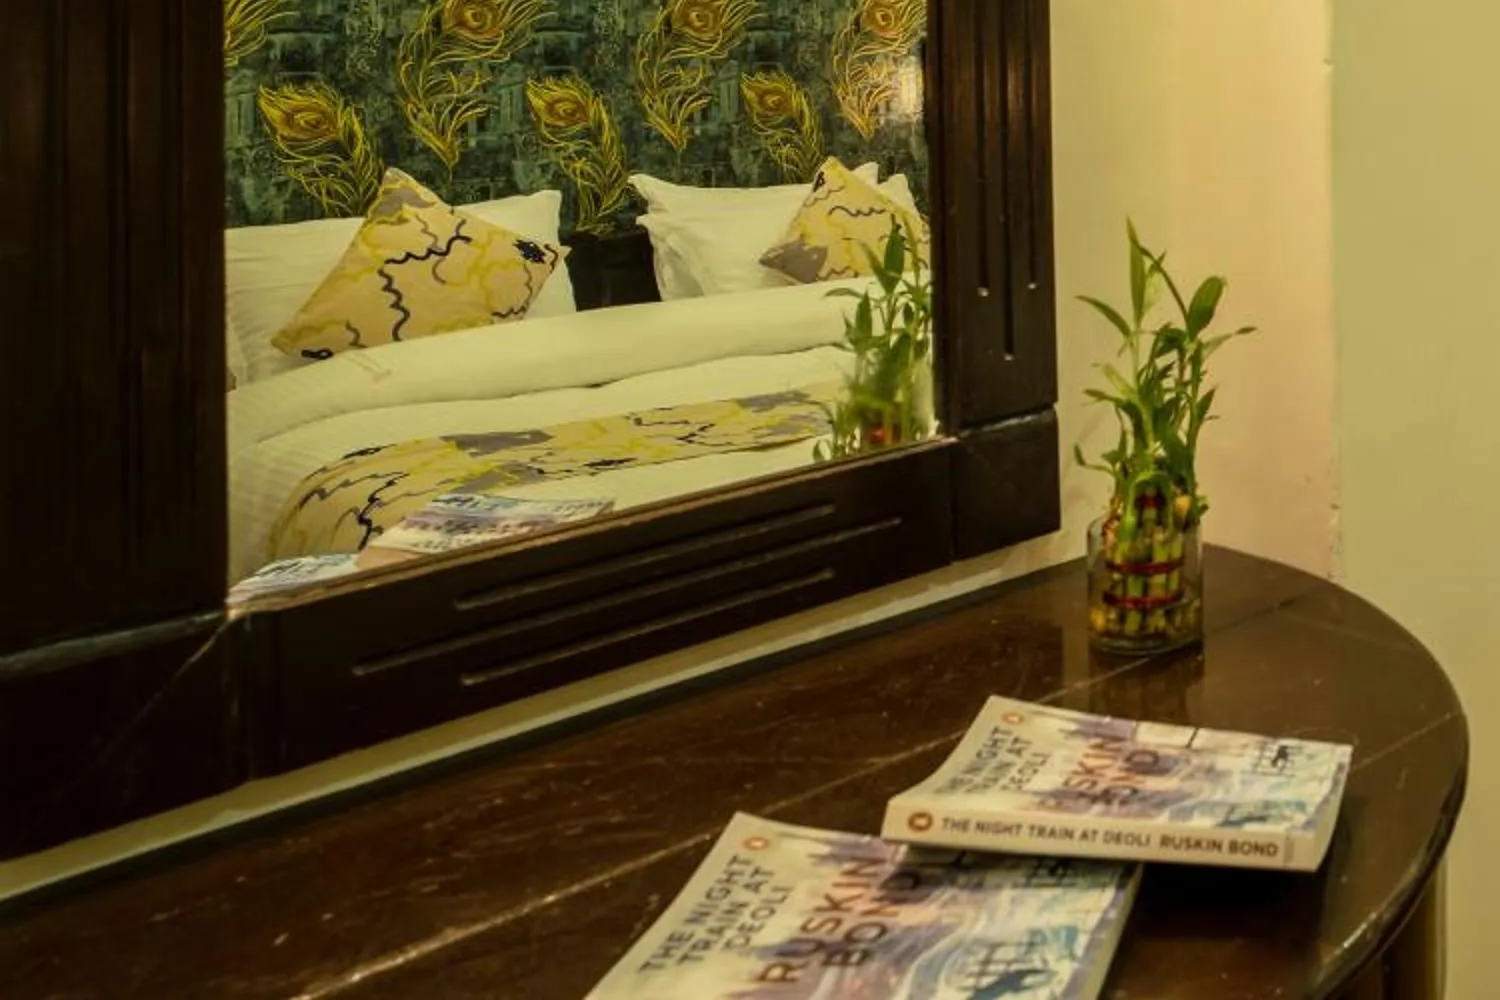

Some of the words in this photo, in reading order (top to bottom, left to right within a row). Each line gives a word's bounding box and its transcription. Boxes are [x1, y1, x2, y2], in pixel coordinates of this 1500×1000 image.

[941, 817, 971, 832] THE
[976, 820, 1023, 836] NIGHT
[1029, 825, 1074, 841] TRAIN
[1079, 828, 1099, 843] AT
[1103, 830, 1151, 848] DEOLI
[1159, 834, 1223, 853] RUSKIN
[1228, 839, 1279, 858] BOND
[637, 930, 693, 973] THE
[683, 853, 756, 926] NIGHT
[675, 900, 748, 966] TRAIN
[741, 865, 776, 896] AT
[723, 885, 796, 951] DEOLI
[757, 854, 888, 983] RUSKIN
[822, 869, 920, 968] BOND
